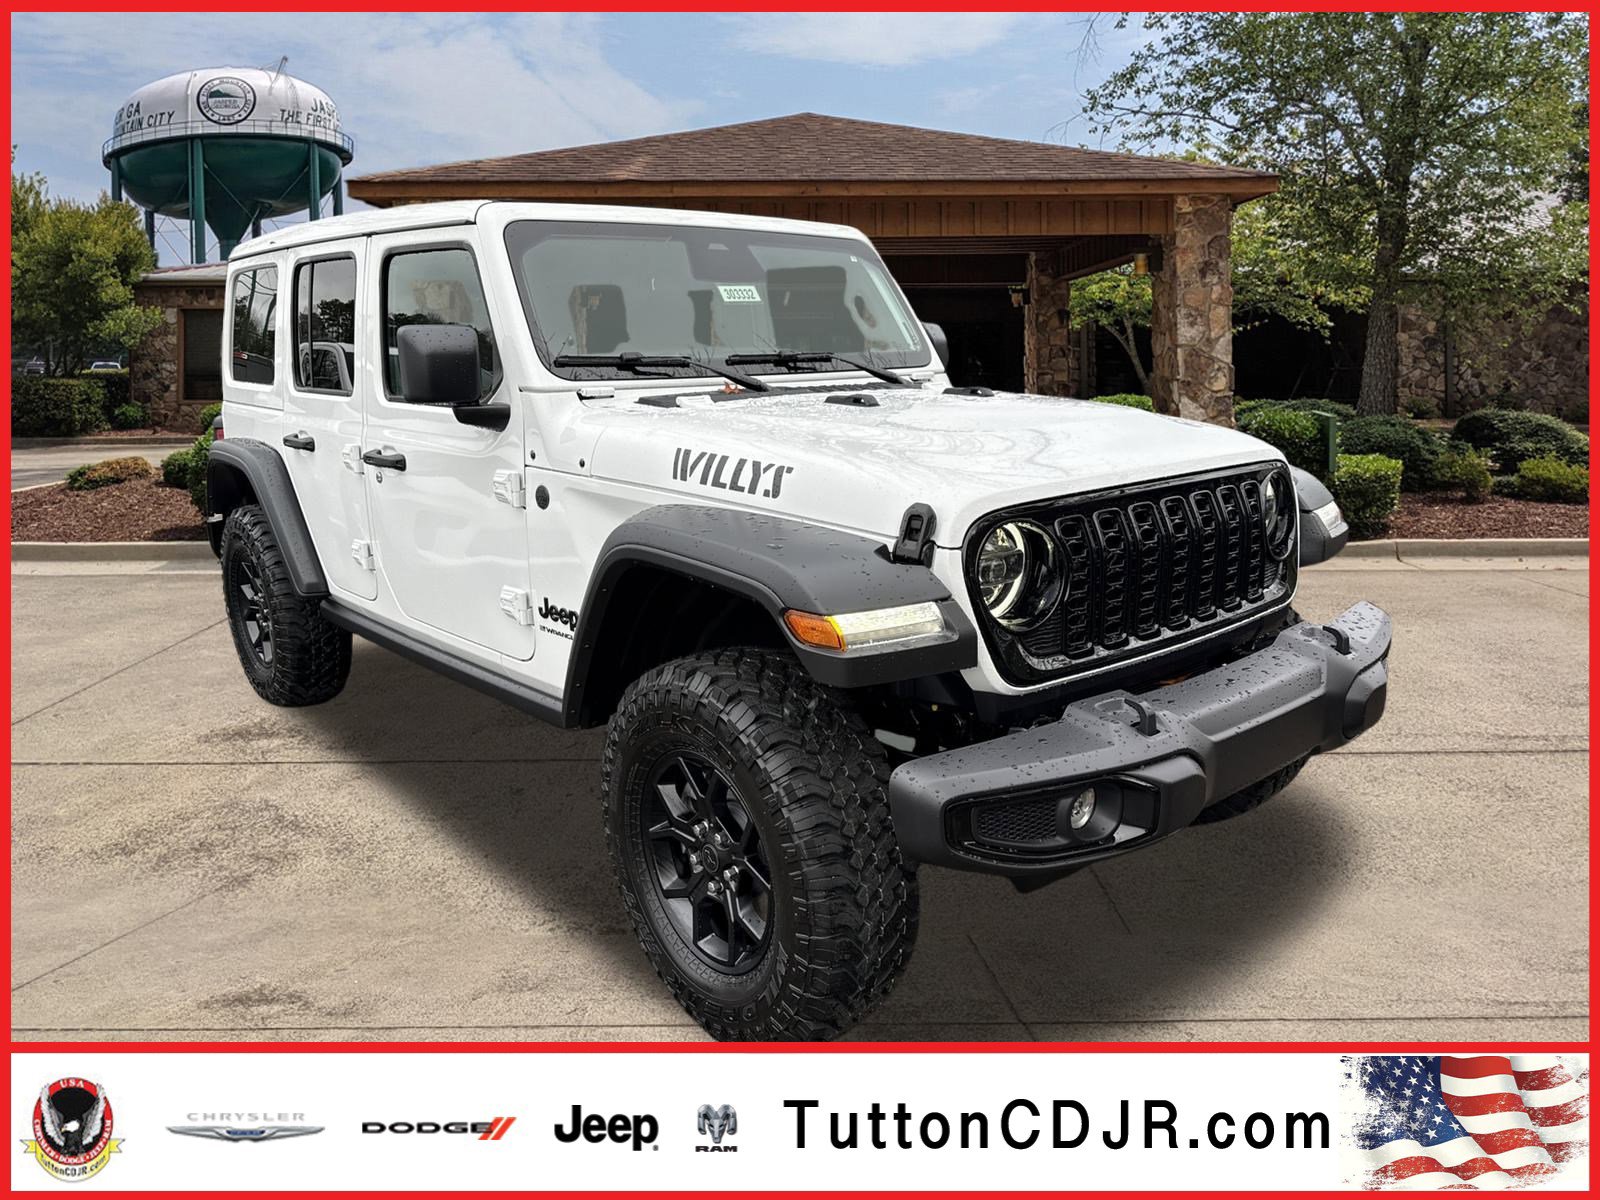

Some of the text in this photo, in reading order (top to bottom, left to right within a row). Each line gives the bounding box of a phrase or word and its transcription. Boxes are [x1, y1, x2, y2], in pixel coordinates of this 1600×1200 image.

[126, 100, 141, 119] GA
[147, 110, 175, 127] CITY
[280, 108, 302, 124] THE
[306, 112, 332, 129] FIRST
[724, 288, 757, 300] 303332
[672, 447, 794, 499] WILLYS
[538, 597, 579, 632] Jeep
